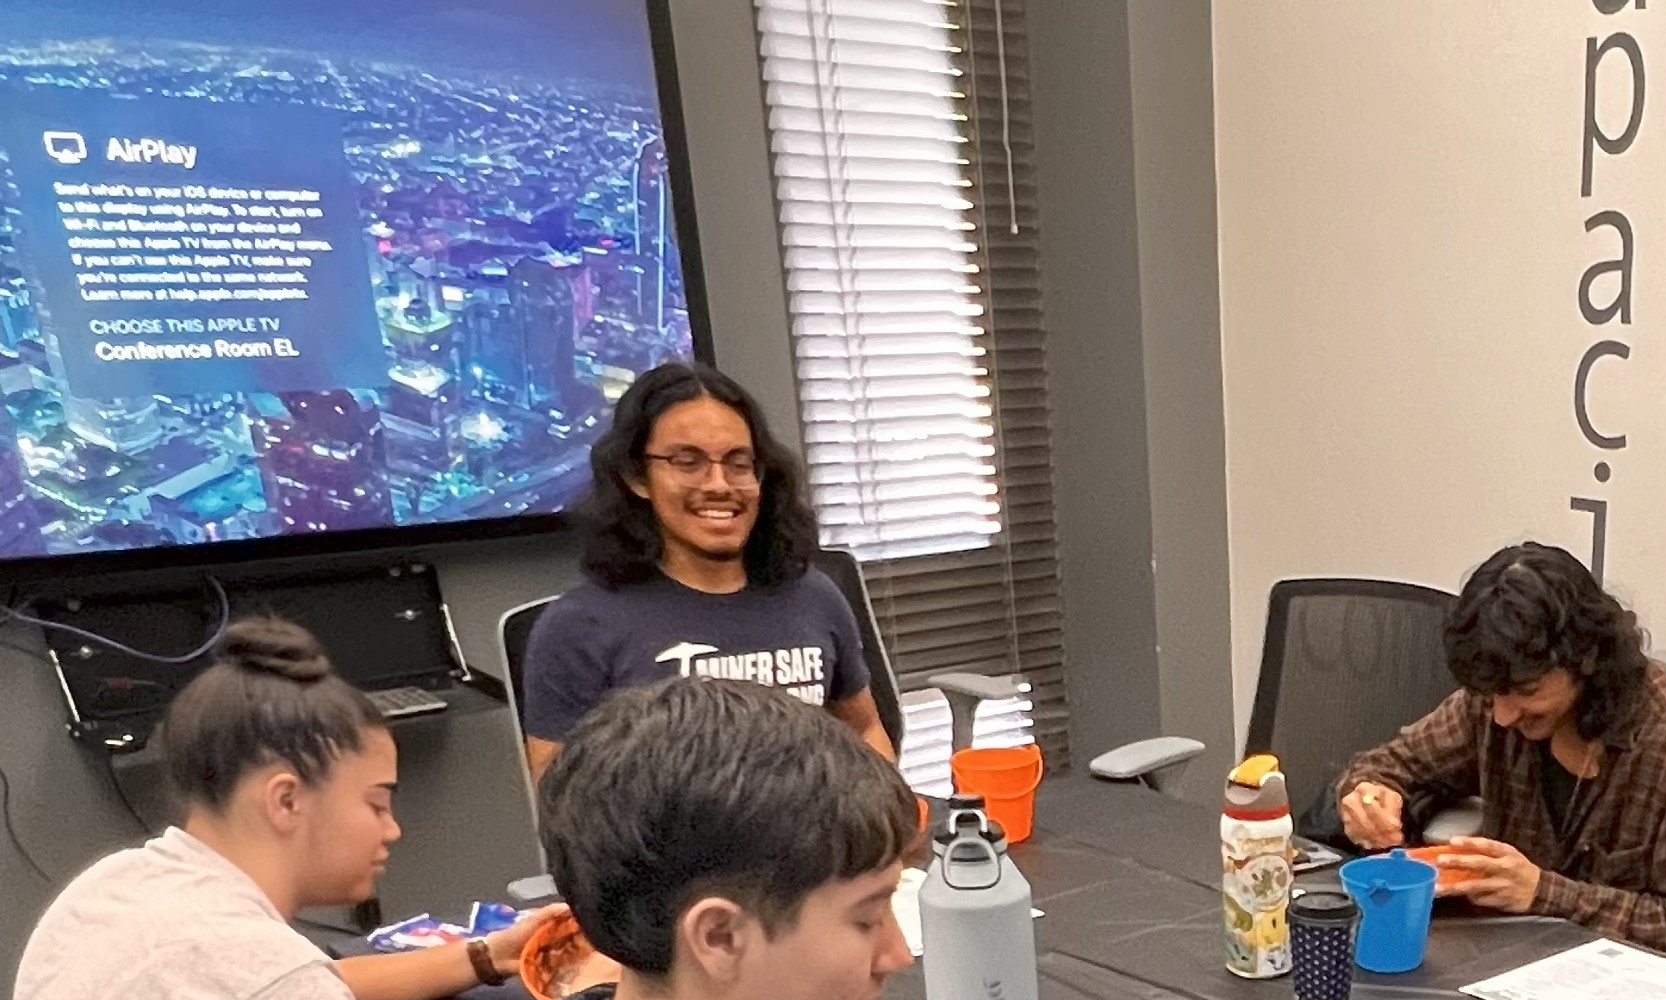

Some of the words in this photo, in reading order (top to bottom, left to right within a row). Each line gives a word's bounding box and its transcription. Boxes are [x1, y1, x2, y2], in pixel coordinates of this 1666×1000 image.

[107, 138, 196, 168] AirPlay
[89, 319, 163, 334] CHOOSE
[165, 319, 204, 332] THIS
[208, 318, 257, 332] APPLE
[259, 317, 279, 332] TV
[94, 341, 212, 361] Conference
[214, 339, 272, 357] Room
[274, 338, 299, 356] EL
[775, 647, 824, 685] SAFE
